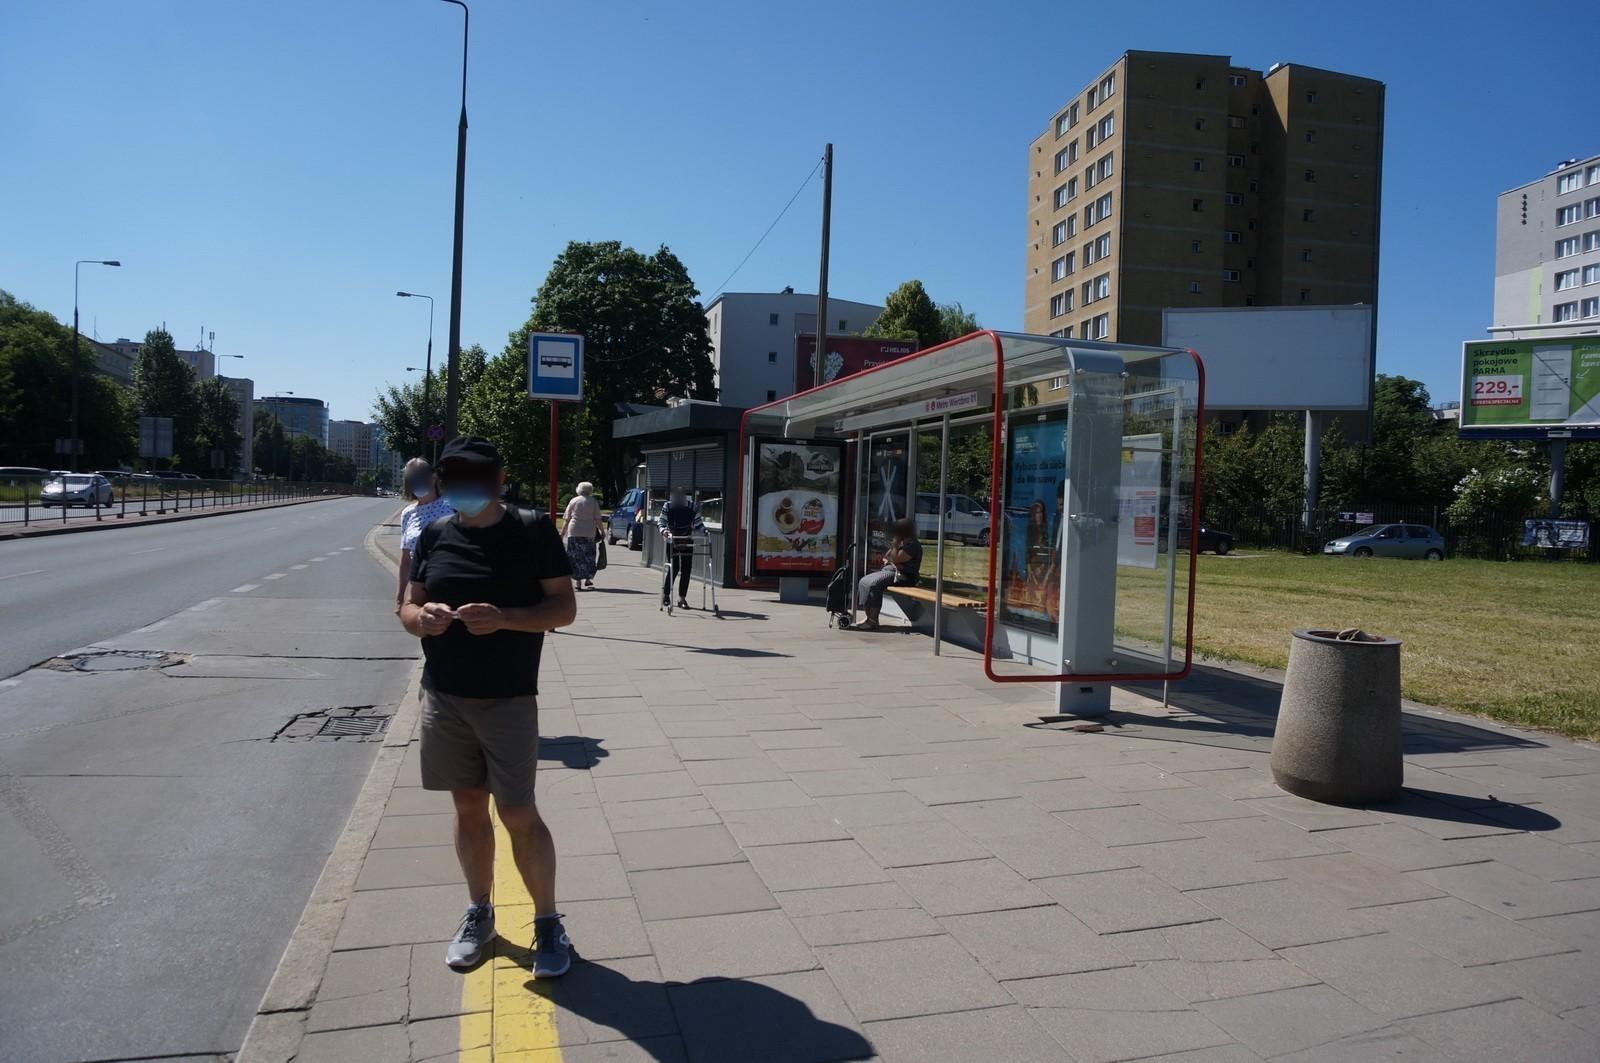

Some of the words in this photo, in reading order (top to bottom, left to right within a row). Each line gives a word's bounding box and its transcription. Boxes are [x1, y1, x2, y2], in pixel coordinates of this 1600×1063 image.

[1473, 358, 1518, 367] pokojowe
[1473, 367, 1506, 375] PARMA
[1474, 381, 1519, 396] 229,-
